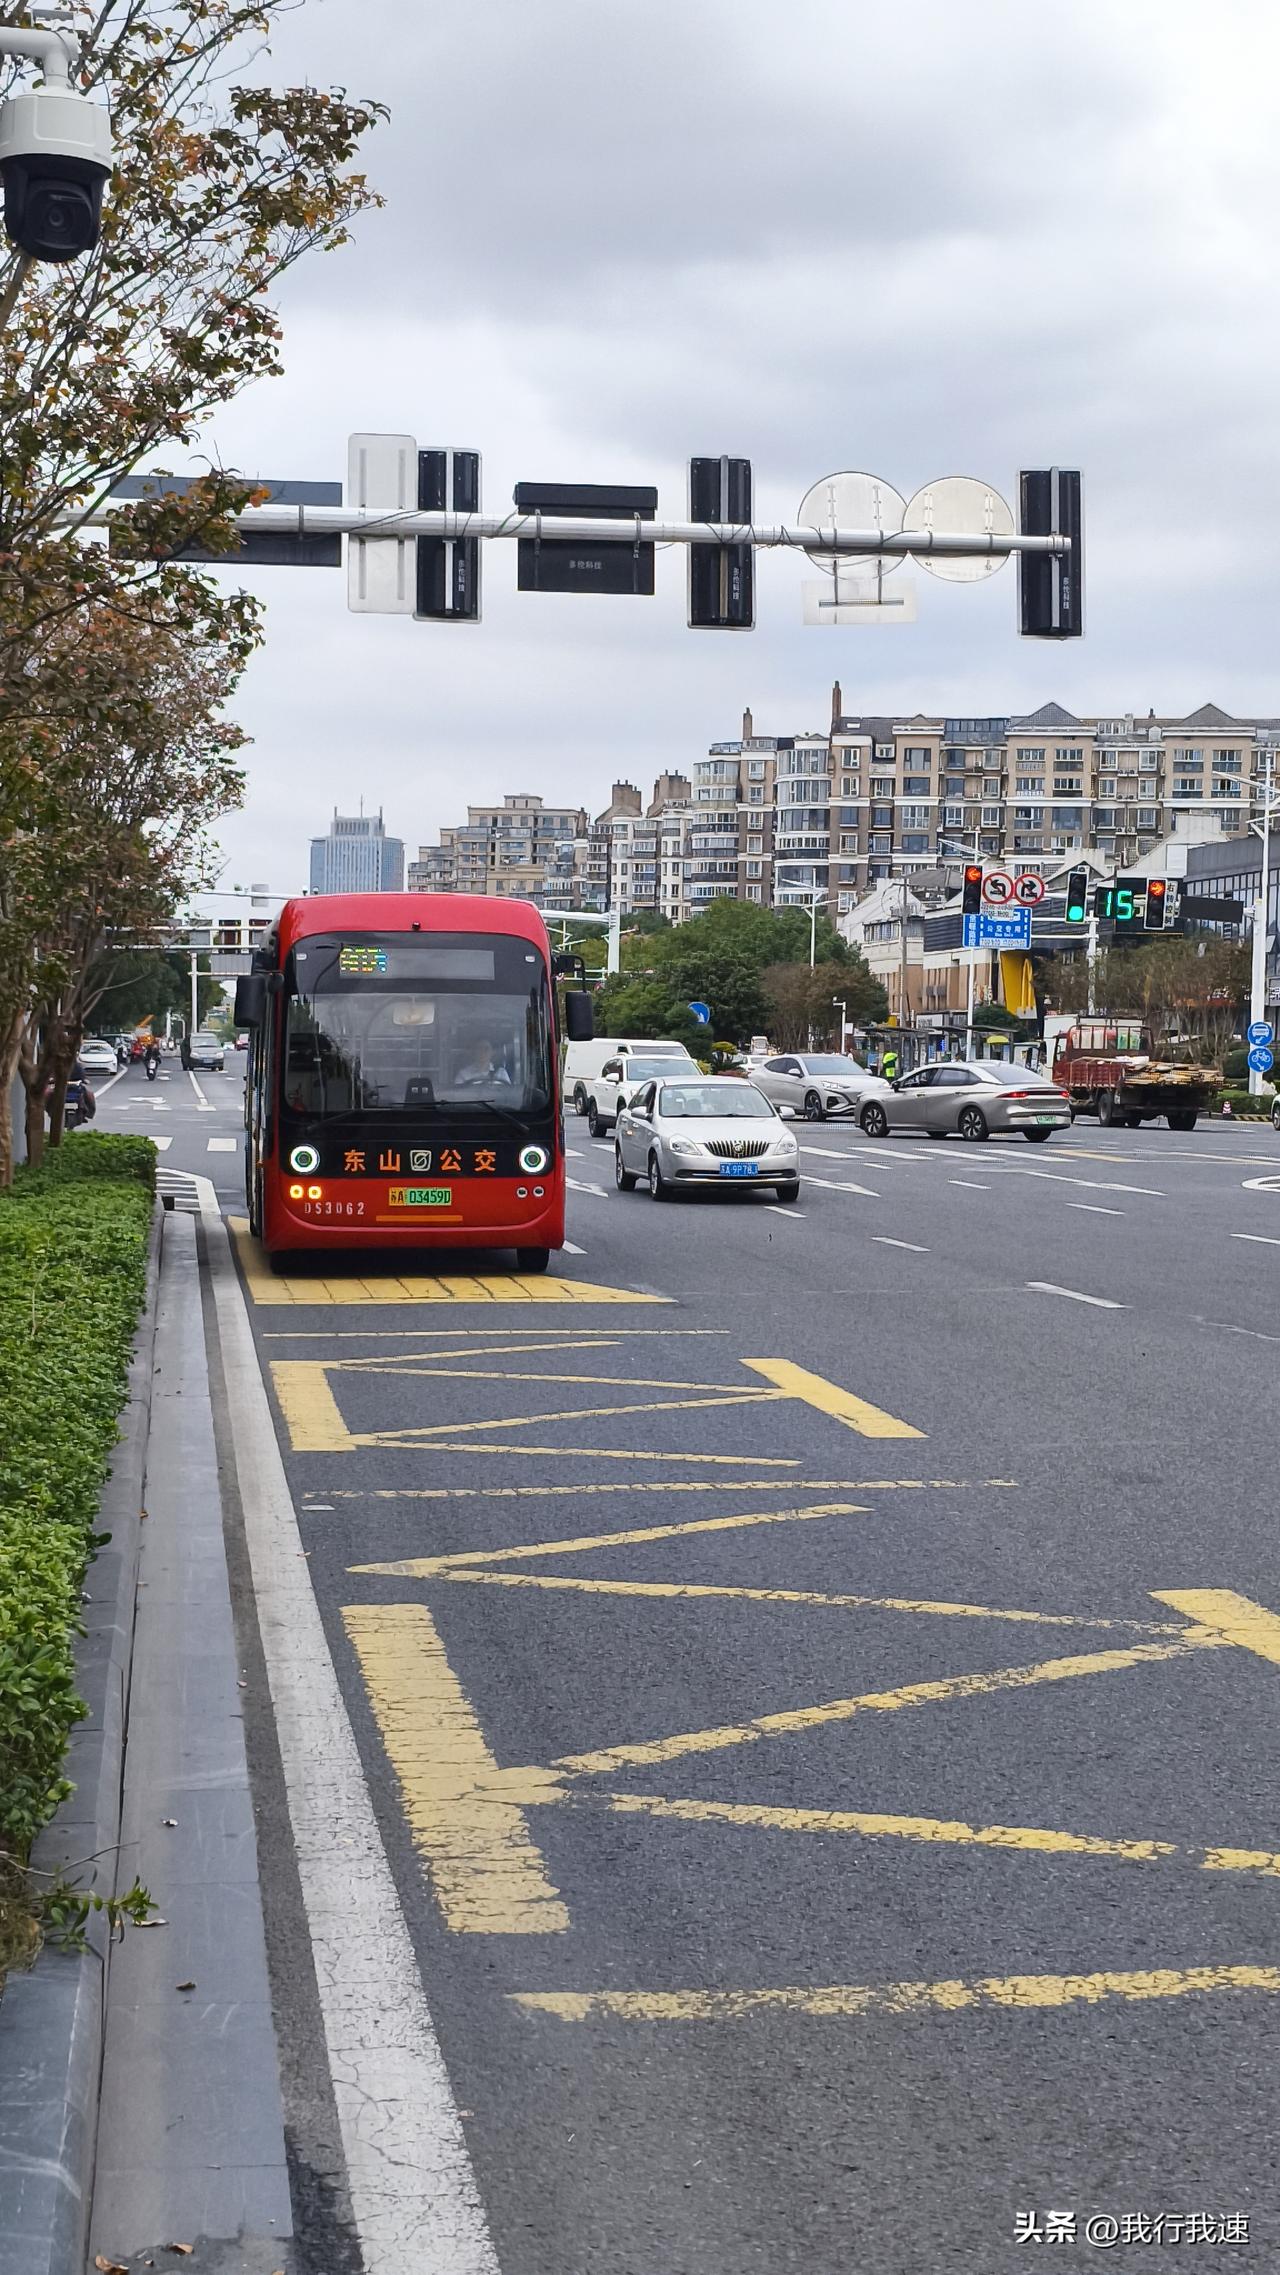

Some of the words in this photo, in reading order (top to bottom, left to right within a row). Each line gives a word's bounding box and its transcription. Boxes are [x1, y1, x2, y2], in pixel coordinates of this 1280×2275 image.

[1106, 890, 1132, 920] 15
[344, 1149, 496, 1173] 东山公交
